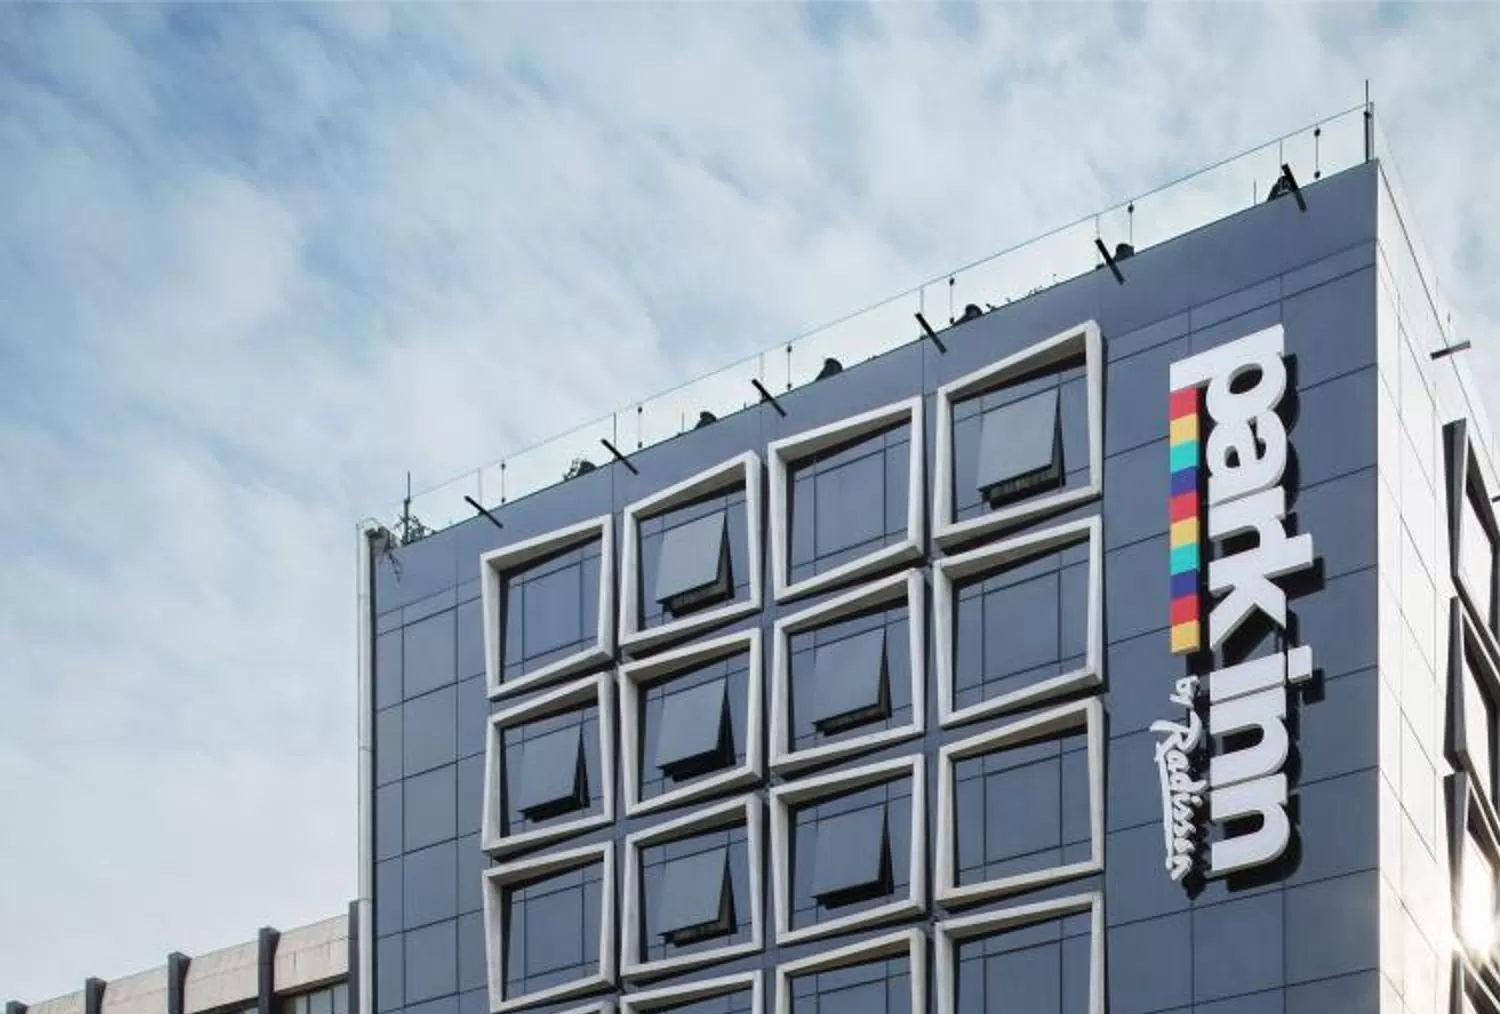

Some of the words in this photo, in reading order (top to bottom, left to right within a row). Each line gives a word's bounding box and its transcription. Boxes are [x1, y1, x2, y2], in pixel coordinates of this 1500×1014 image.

[1169, 324, 1312, 648] park
[1170, 675, 1200, 704] by
[1209, 645, 1313, 878] inn
[1150, 717, 1207, 881] Radisson
